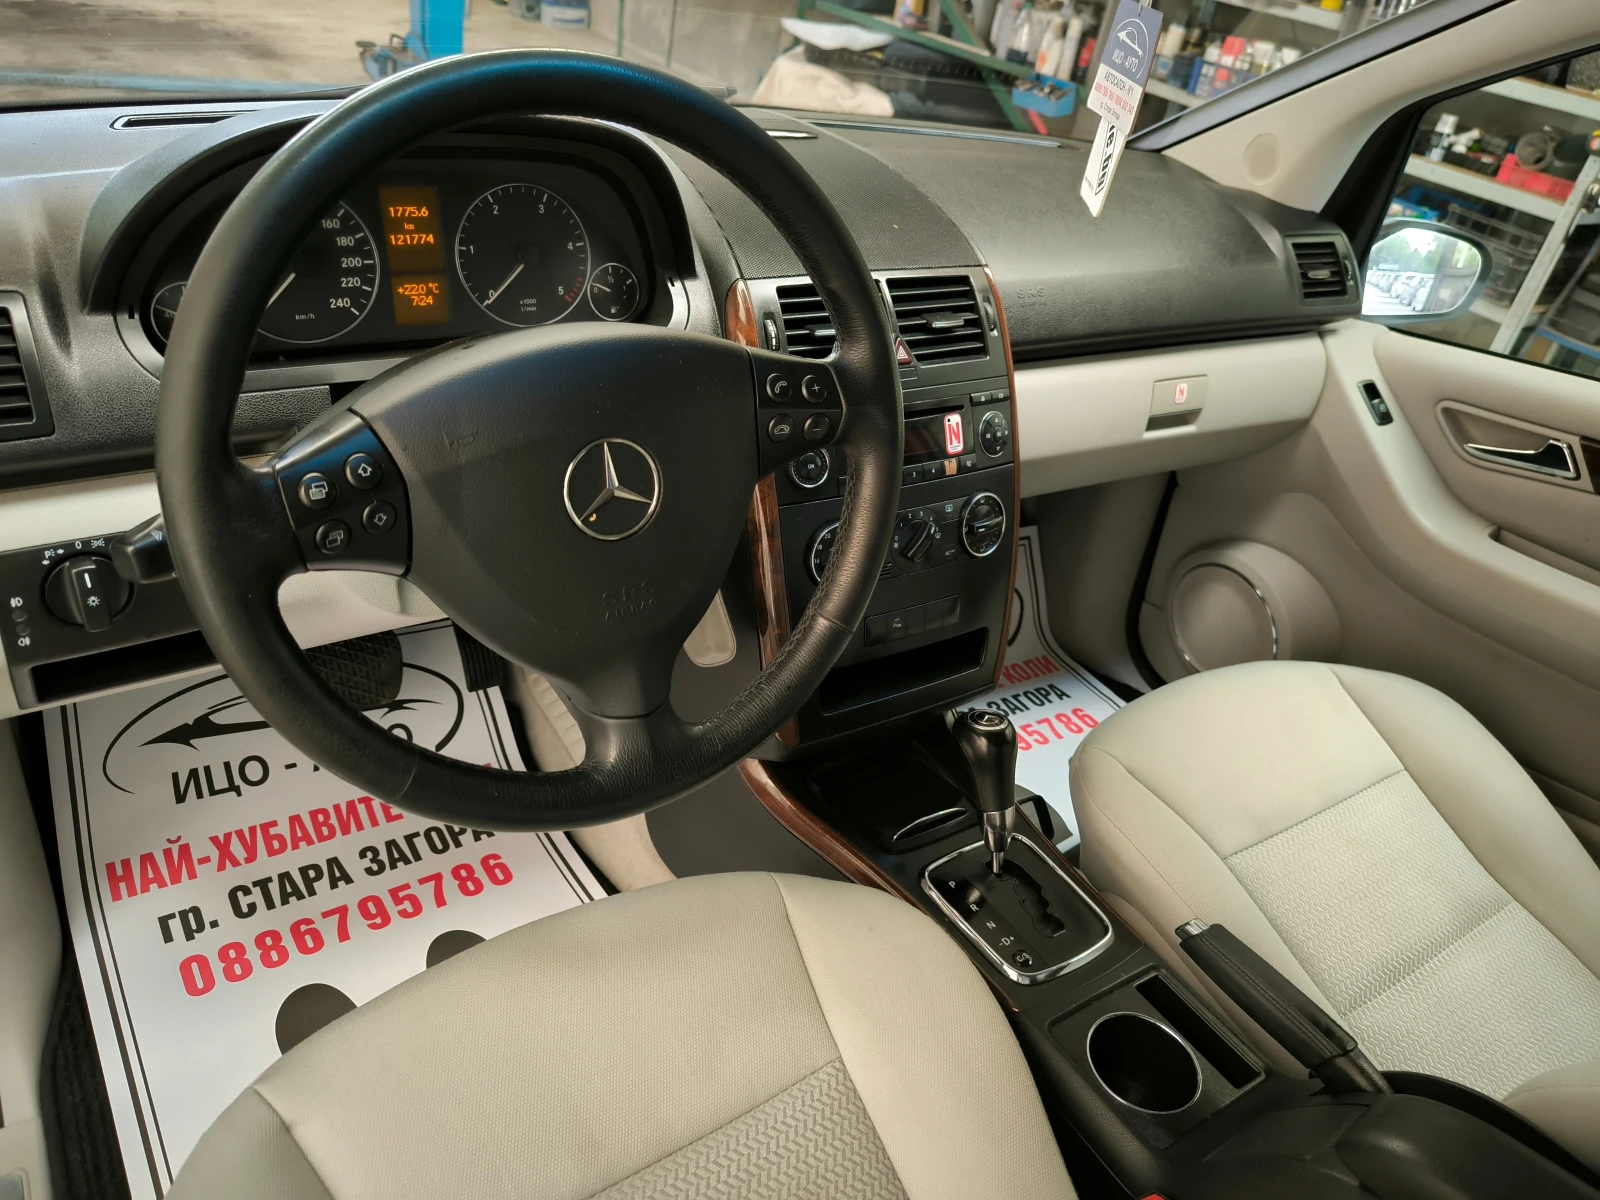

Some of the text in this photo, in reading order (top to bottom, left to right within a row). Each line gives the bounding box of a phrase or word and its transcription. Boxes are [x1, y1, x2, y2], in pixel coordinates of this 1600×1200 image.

[389, 206, 429, 217] 1775.6
[493, 205, 499, 214] 2
[538, 204, 545, 214] 3
[321, 218, 340, 229] 160
[336, 236, 354, 246] 180
[390, 233, 435, 245] 121774
[567, 241, 574, 250] 4
[341, 257, 362, 267] 200
[340, 277, 361, 287] 220
[558, 287, 564, 295] 5
[329, 298, 351, 308] 240
[411, 295, 434, 306] 7:24
[295, 313, 315, 321] km/h
[947, 421, 961, 446] N
[1001, 655, 1060, 684] КОЛИ
[986, 683, 1072, 718] ЗАГОРА
[171, 754, 271, 804] ИЦО
[104, 795, 405, 902] НАЙ-ХУБАВИТЕ
[949, 881, 956, 889] P
[157, 905, 219, 945] гр.
[227, 859, 354, 920] СТАРА
[969, 904, 980, 912] R
[178, 852, 515, 998] 0886795786
[986, 921, 996, 929] N
